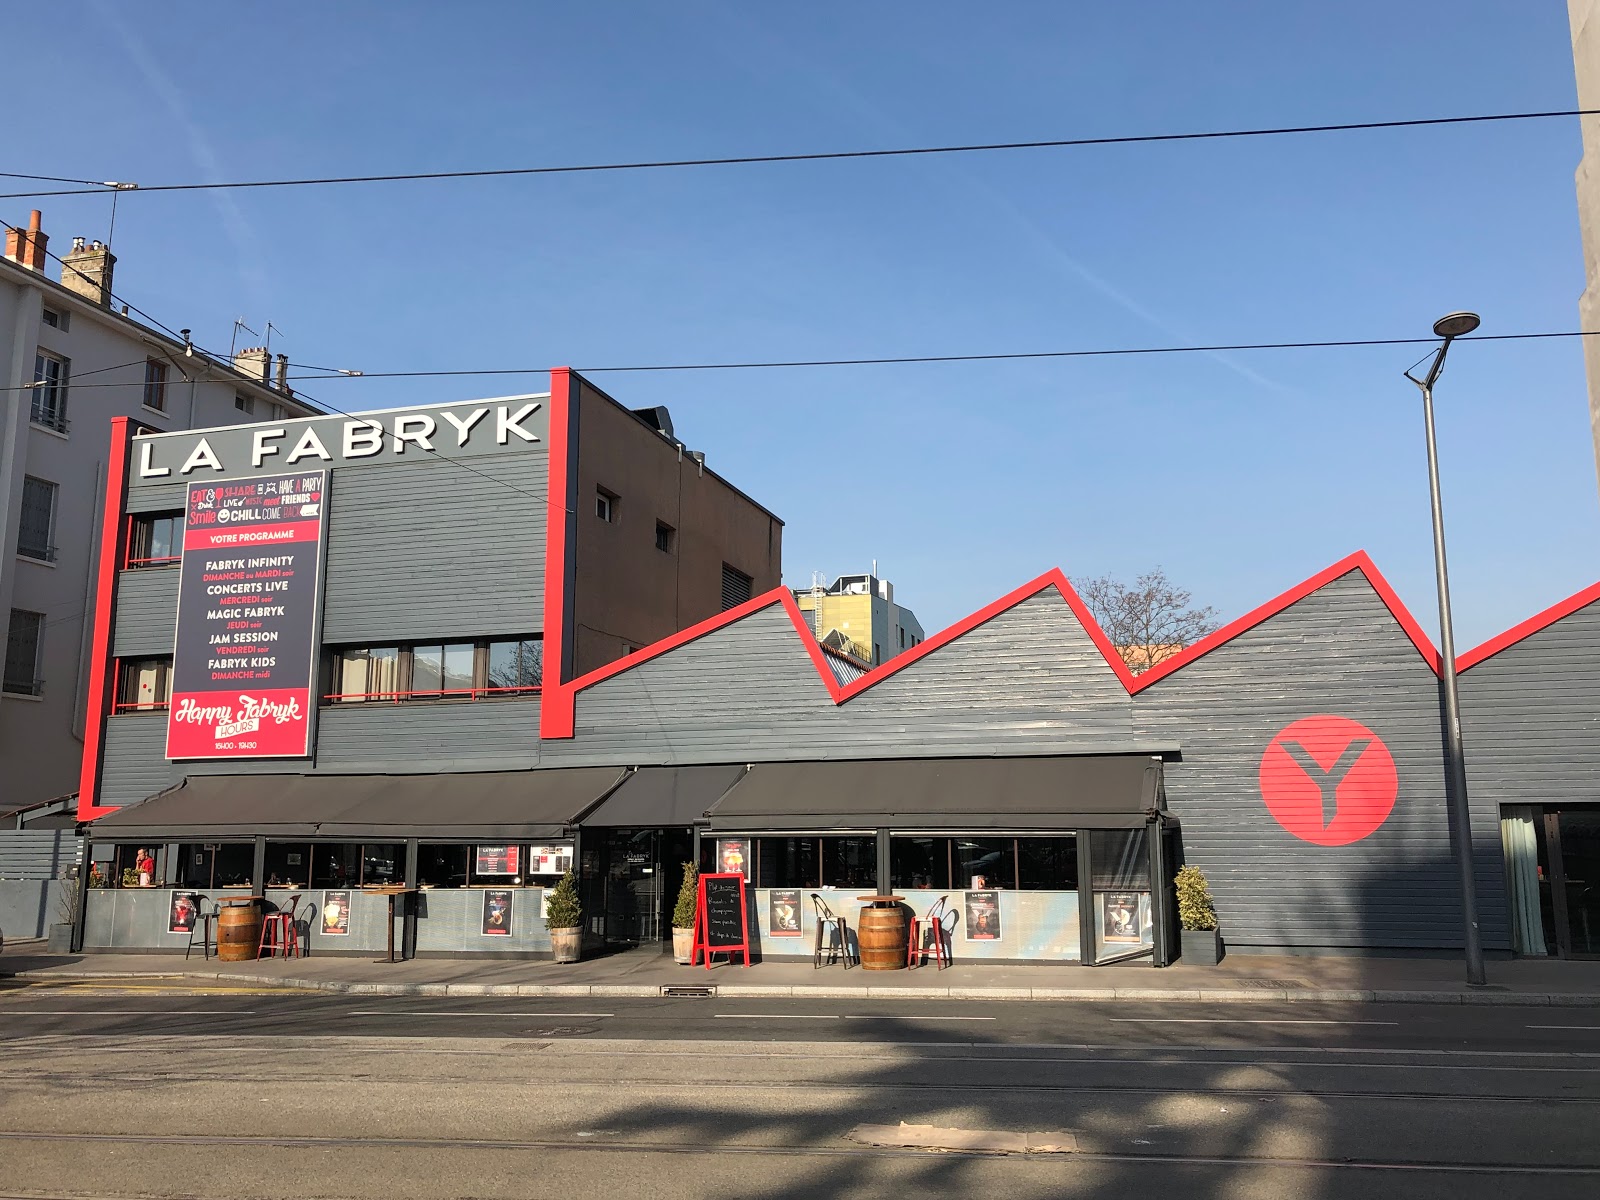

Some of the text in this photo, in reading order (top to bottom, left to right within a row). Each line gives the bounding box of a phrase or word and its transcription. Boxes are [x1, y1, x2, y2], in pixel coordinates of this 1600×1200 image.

[139, 403, 541, 477] LA FABRYK
[224, 485, 256, 498] SHARE
[279, 477, 322, 495] HAVE A PARTY
[191, 489, 208, 503] EAT
[223, 498, 239, 508] LIVE
[281, 493, 311, 505] FRIENDS
[189, 510, 216, 525] Smile
[230, 508, 261, 522] CHILL
[262, 507, 281, 521] COME
[210, 529, 295, 544] VOTRE PROGRAMME
[206, 556, 294, 571] FABRYK INFINITY
[203, 571, 245, 582] DIMANCHE
[255, 569, 281, 579] MARDI
[282, 569, 294, 577] soir
[207, 581, 289, 595] CONCERTS LIVE
[219, 596, 260, 605] MERCREDI
[206, 606, 285, 620] MAGIC FABRYK
[226, 621, 249, 630] JEUDI
[209, 631, 279, 645] JAM SESSION
[216, 646, 256, 655] VENDREDI
[208, 656, 276, 669] FABRYK KIDS
[211, 670, 270, 680] DIMANCHE midi
[175, 694, 303, 726] Happy Fabryk
[220, 720, 254, 737] HOURS
